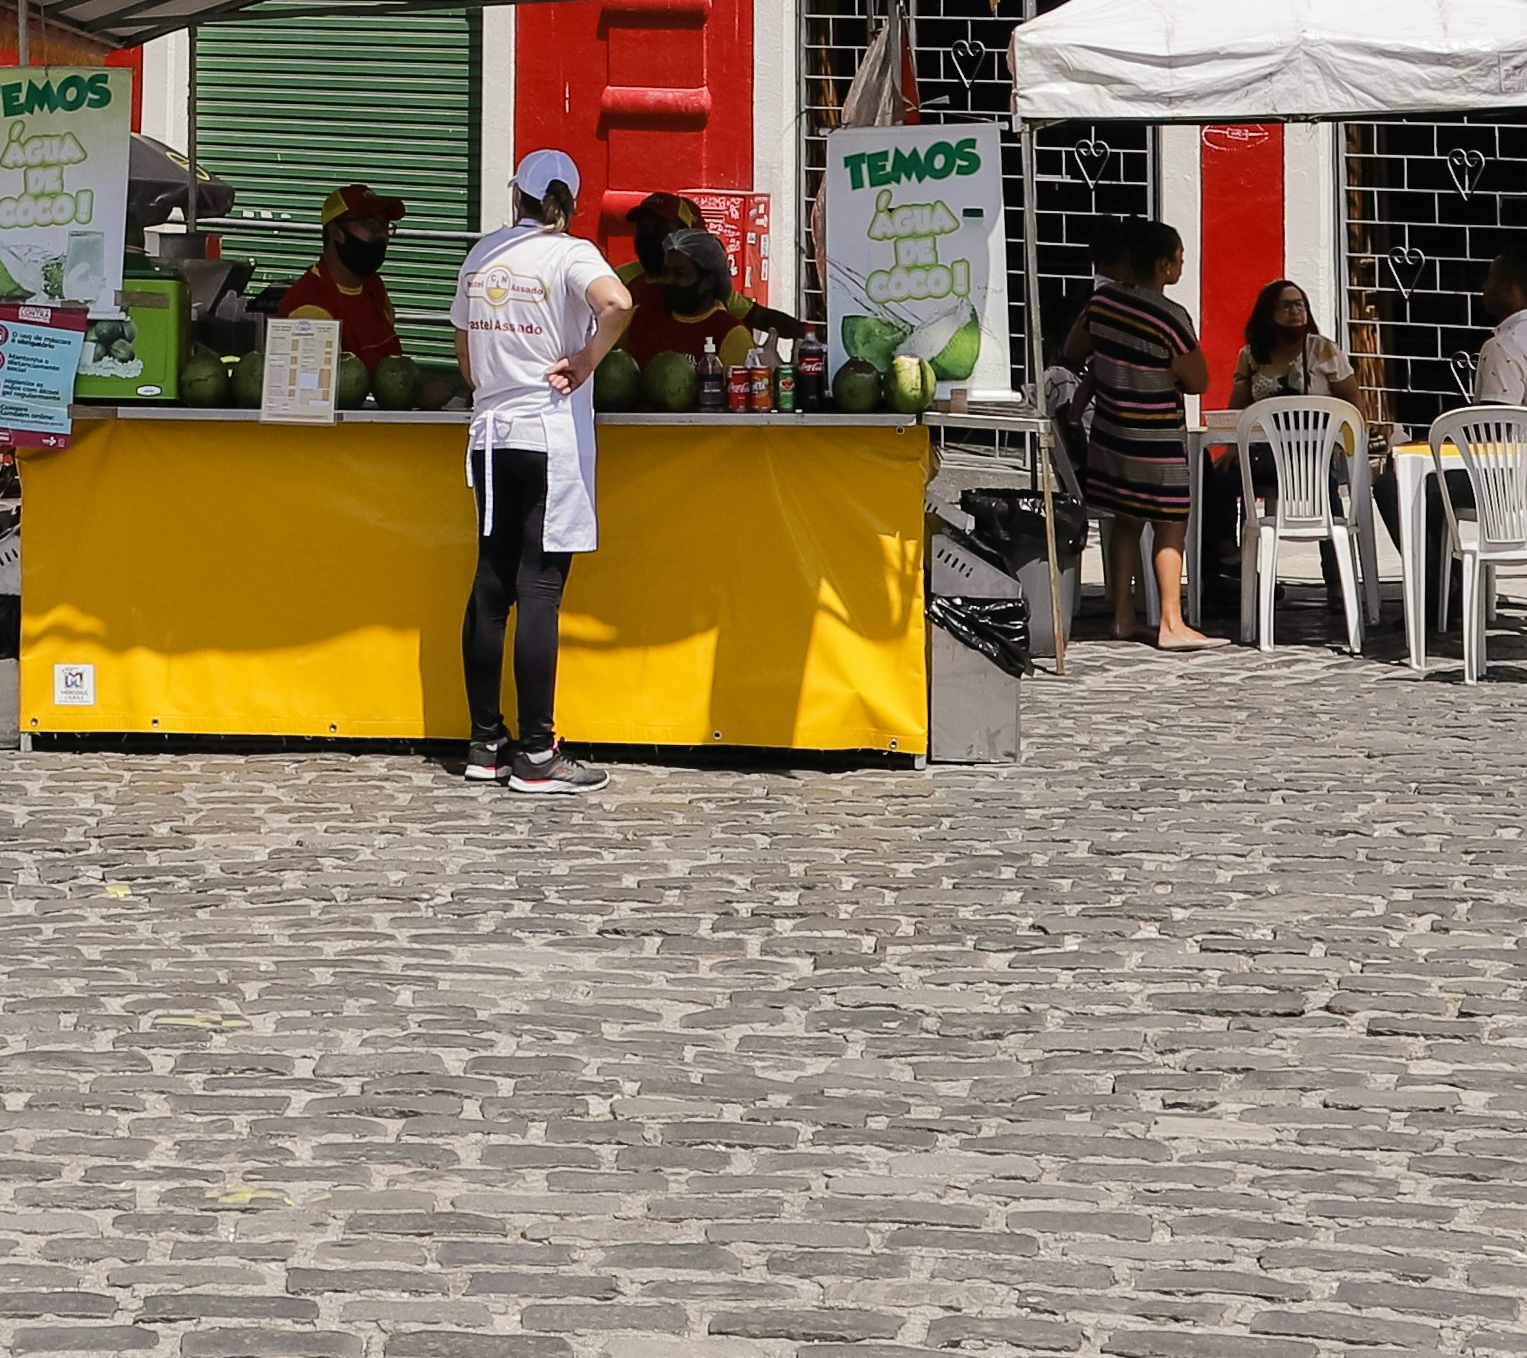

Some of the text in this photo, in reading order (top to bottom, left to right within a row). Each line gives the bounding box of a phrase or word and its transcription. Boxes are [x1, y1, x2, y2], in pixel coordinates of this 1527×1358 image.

[0, 120, 87, 169] ÁGUA
[843, 138, 981, 191] TEMOS
[24, 165, 63, 196] DE
[868, 189, 960, 241] ÁGUA
[895, 235, 938, 268] DE
[469, 319, 543, 335] astel Assado
